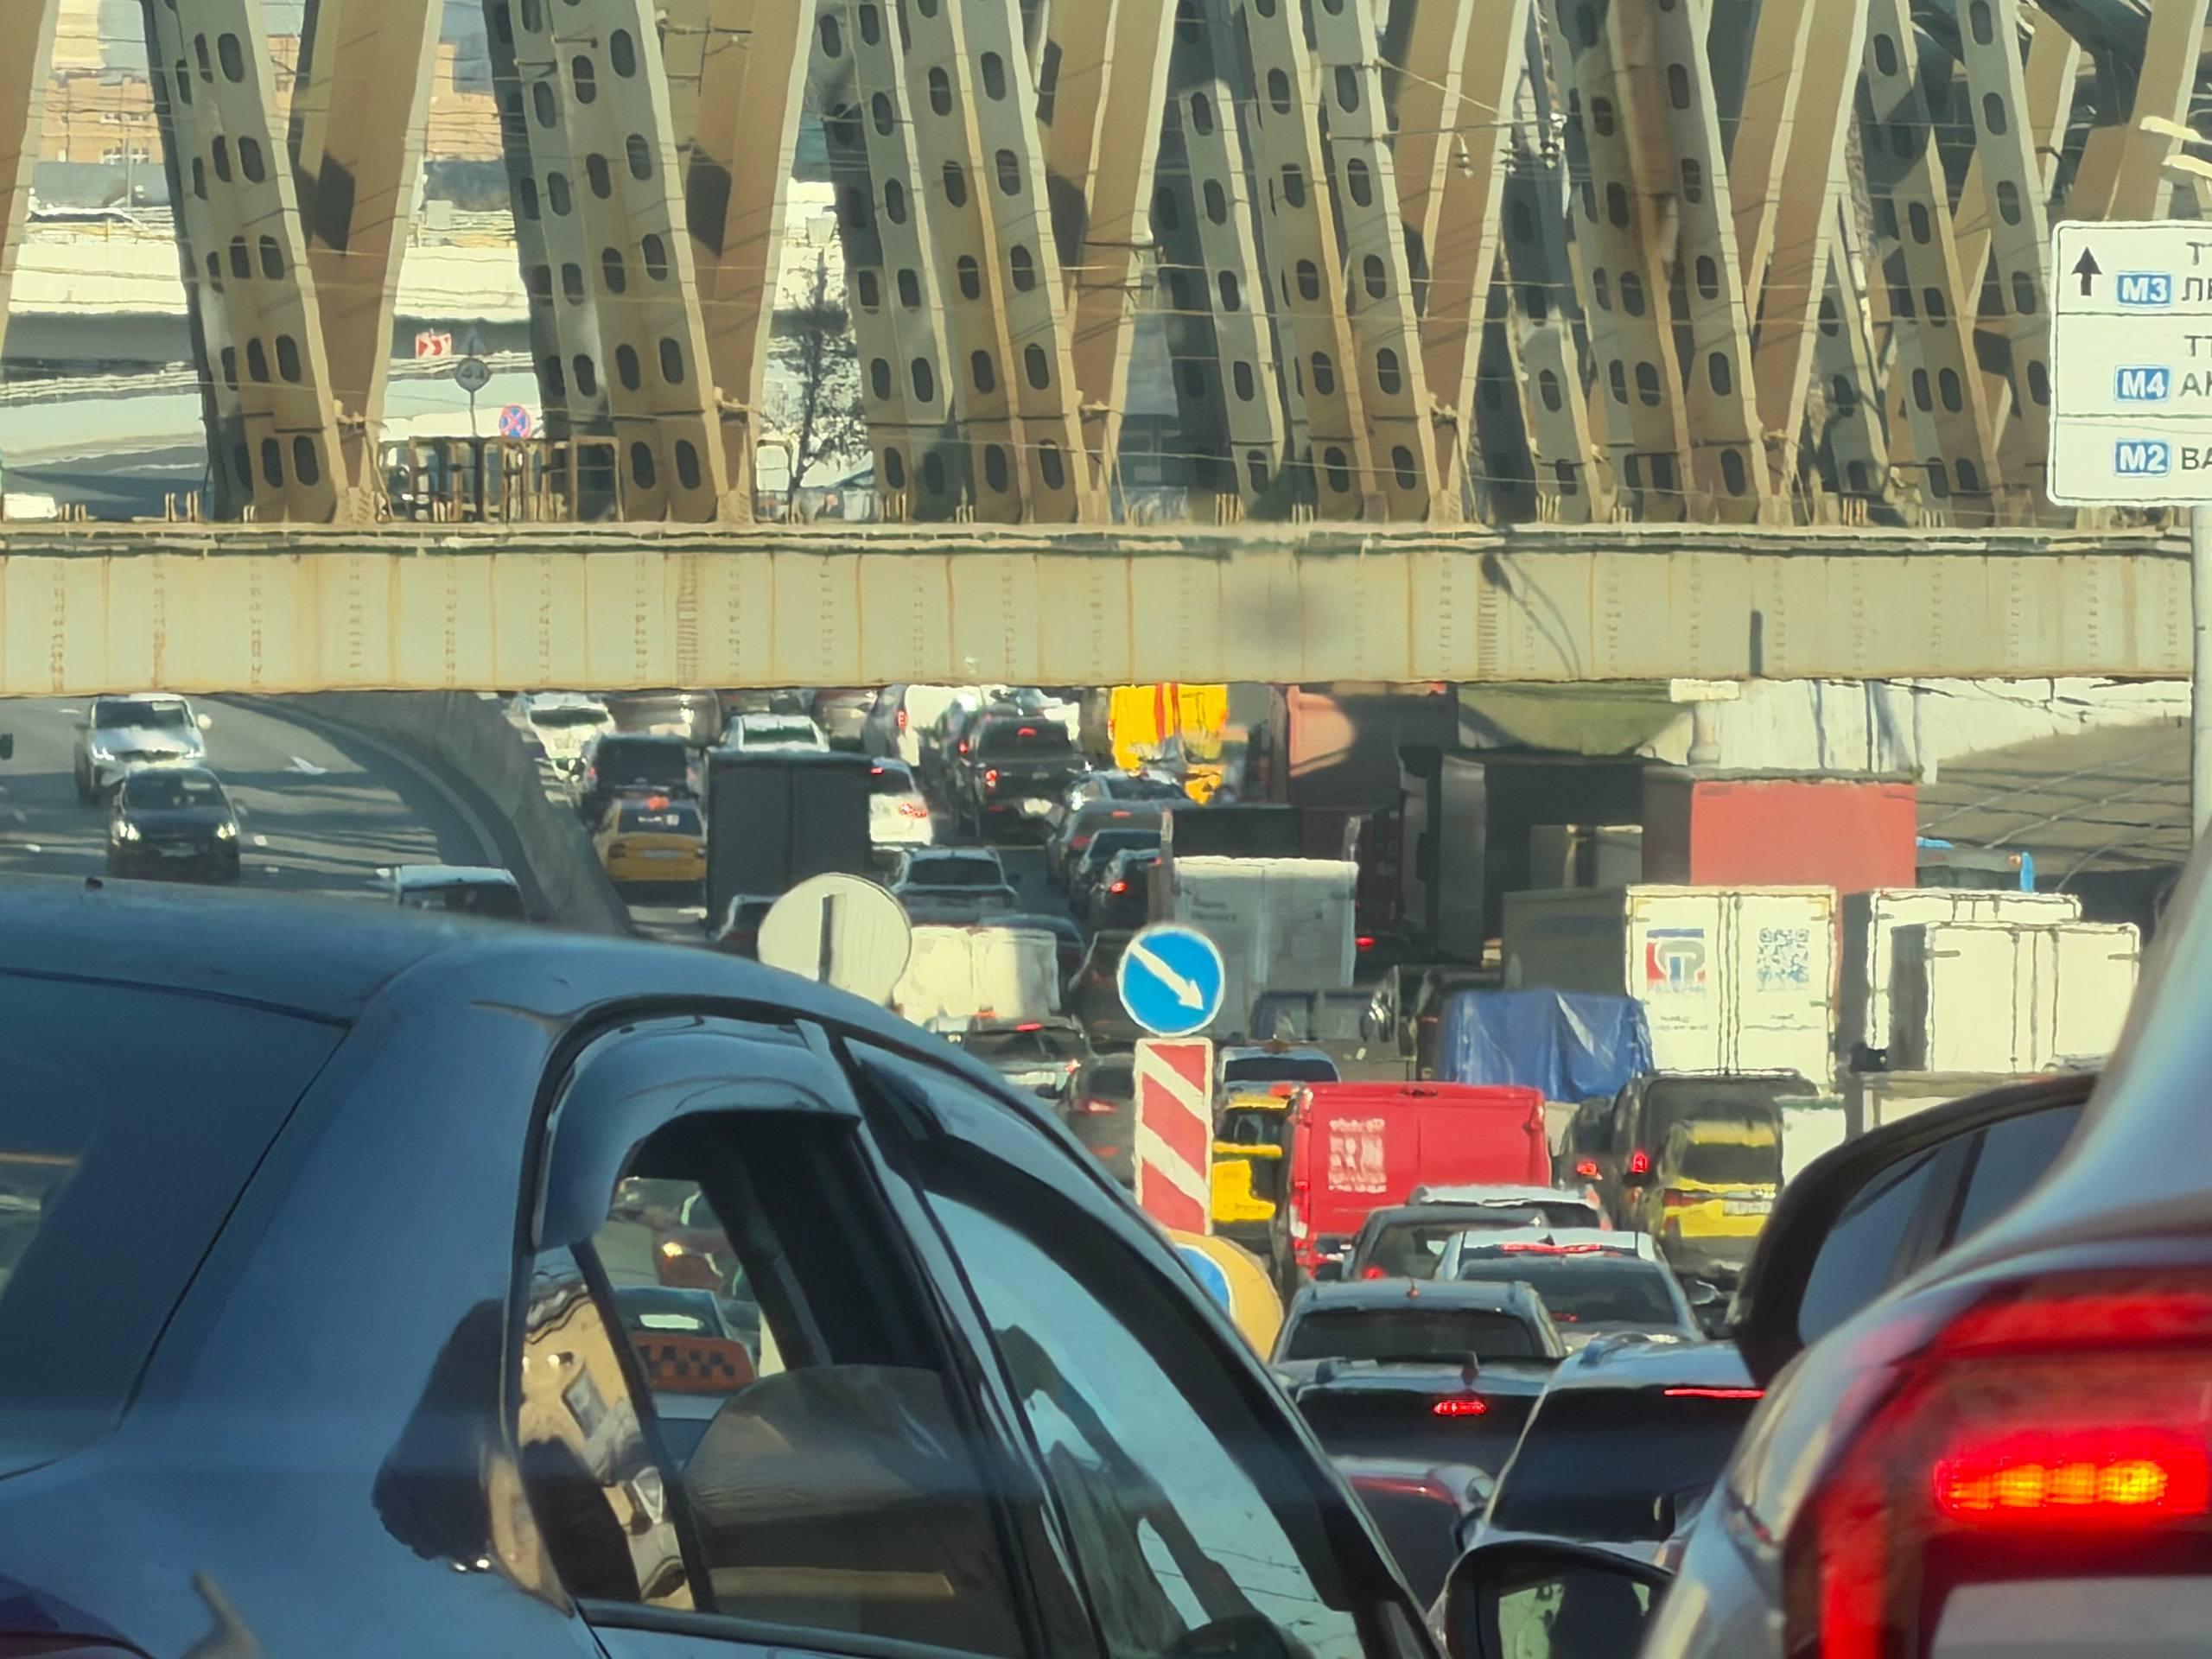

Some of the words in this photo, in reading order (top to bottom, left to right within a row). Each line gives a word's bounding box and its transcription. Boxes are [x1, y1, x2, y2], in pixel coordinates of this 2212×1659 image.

[2122, 276, 2167, 302] М3
[2181, 276, 2212, 302] Л
[2121, 370, 2165, 399] М4
[2120, 444, 2166, 473] М2
